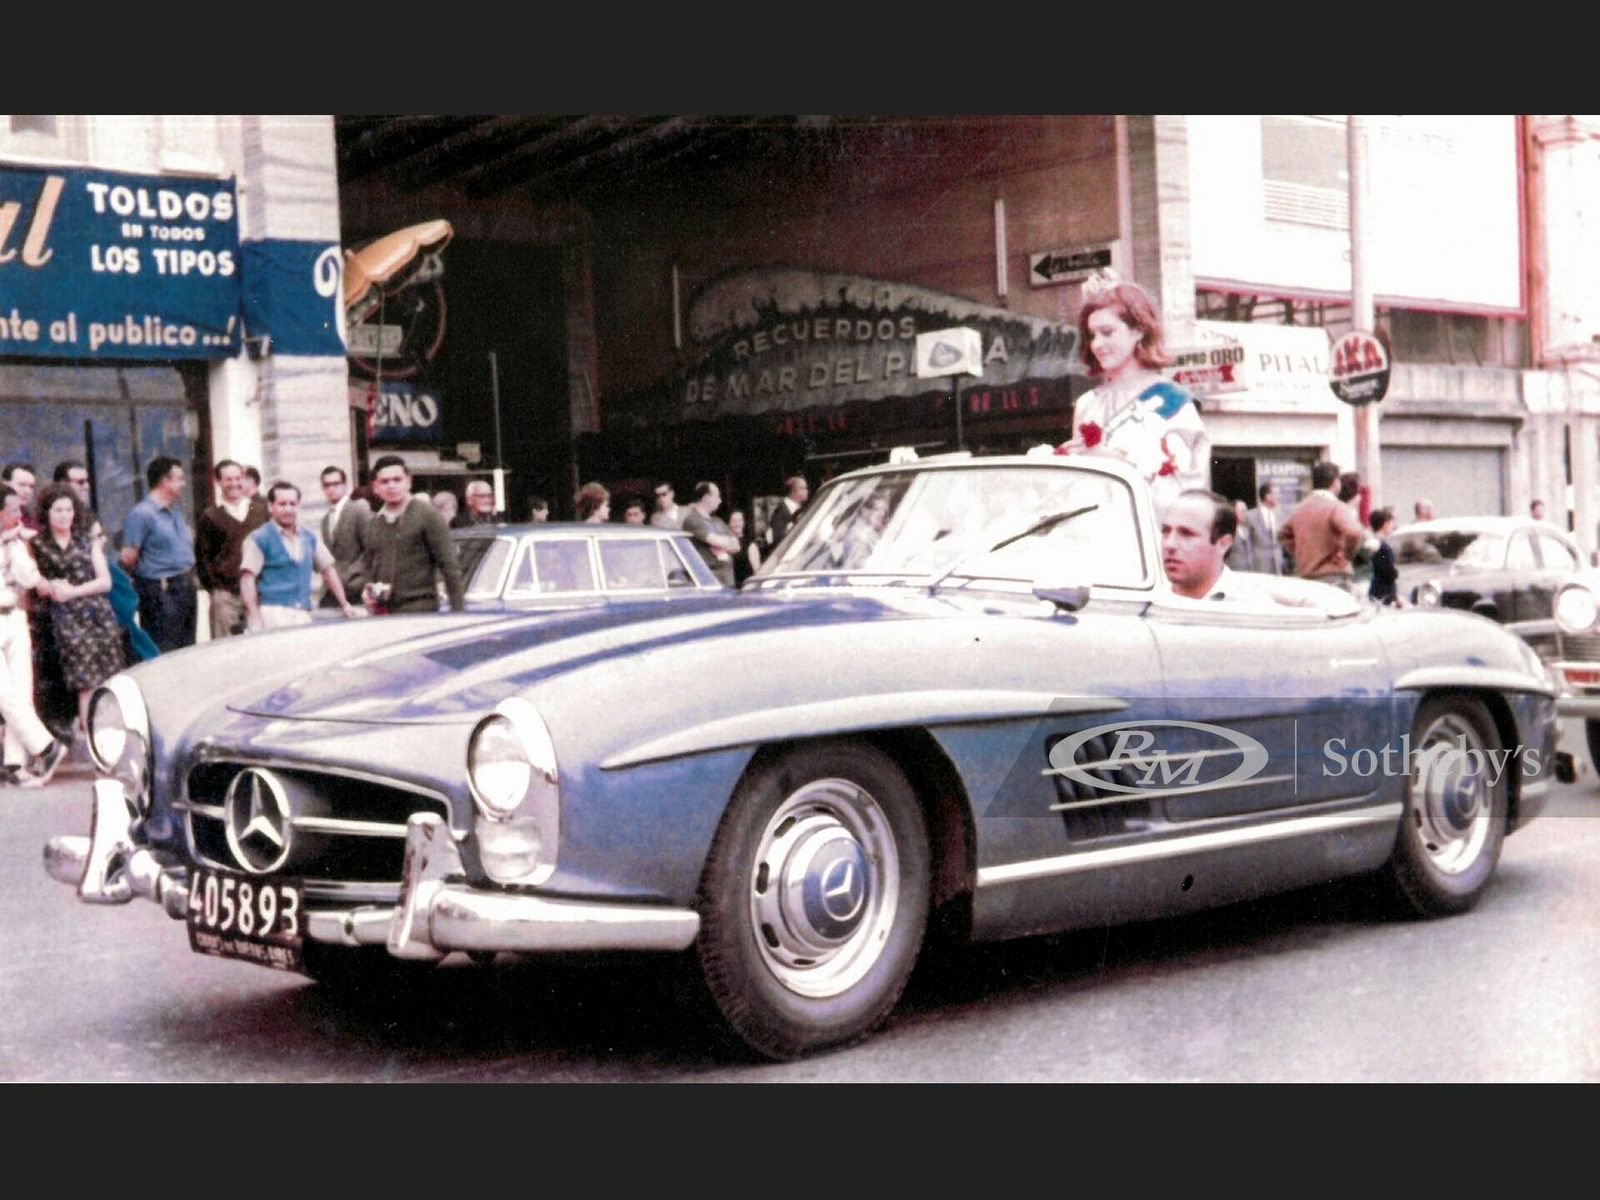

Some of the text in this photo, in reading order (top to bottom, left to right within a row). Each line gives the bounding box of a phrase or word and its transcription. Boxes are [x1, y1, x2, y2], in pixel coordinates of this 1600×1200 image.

[86, 182, 234, 221] TOLDOS
[122, 223, 205, 241] EN TODOS
[91, 245, 235, 276] LOS TIPOS
[50, 312, 77, 343] al
[733, 315, 916, 361] RECUERDOS
[1210, 346, 1244, 366] ORO
[686, 375, 715, 402] DE
[727, 366, 796, 397] MAR
[808, 354, 869, 389] DEL
[189, 871, 300, 940] 405893
